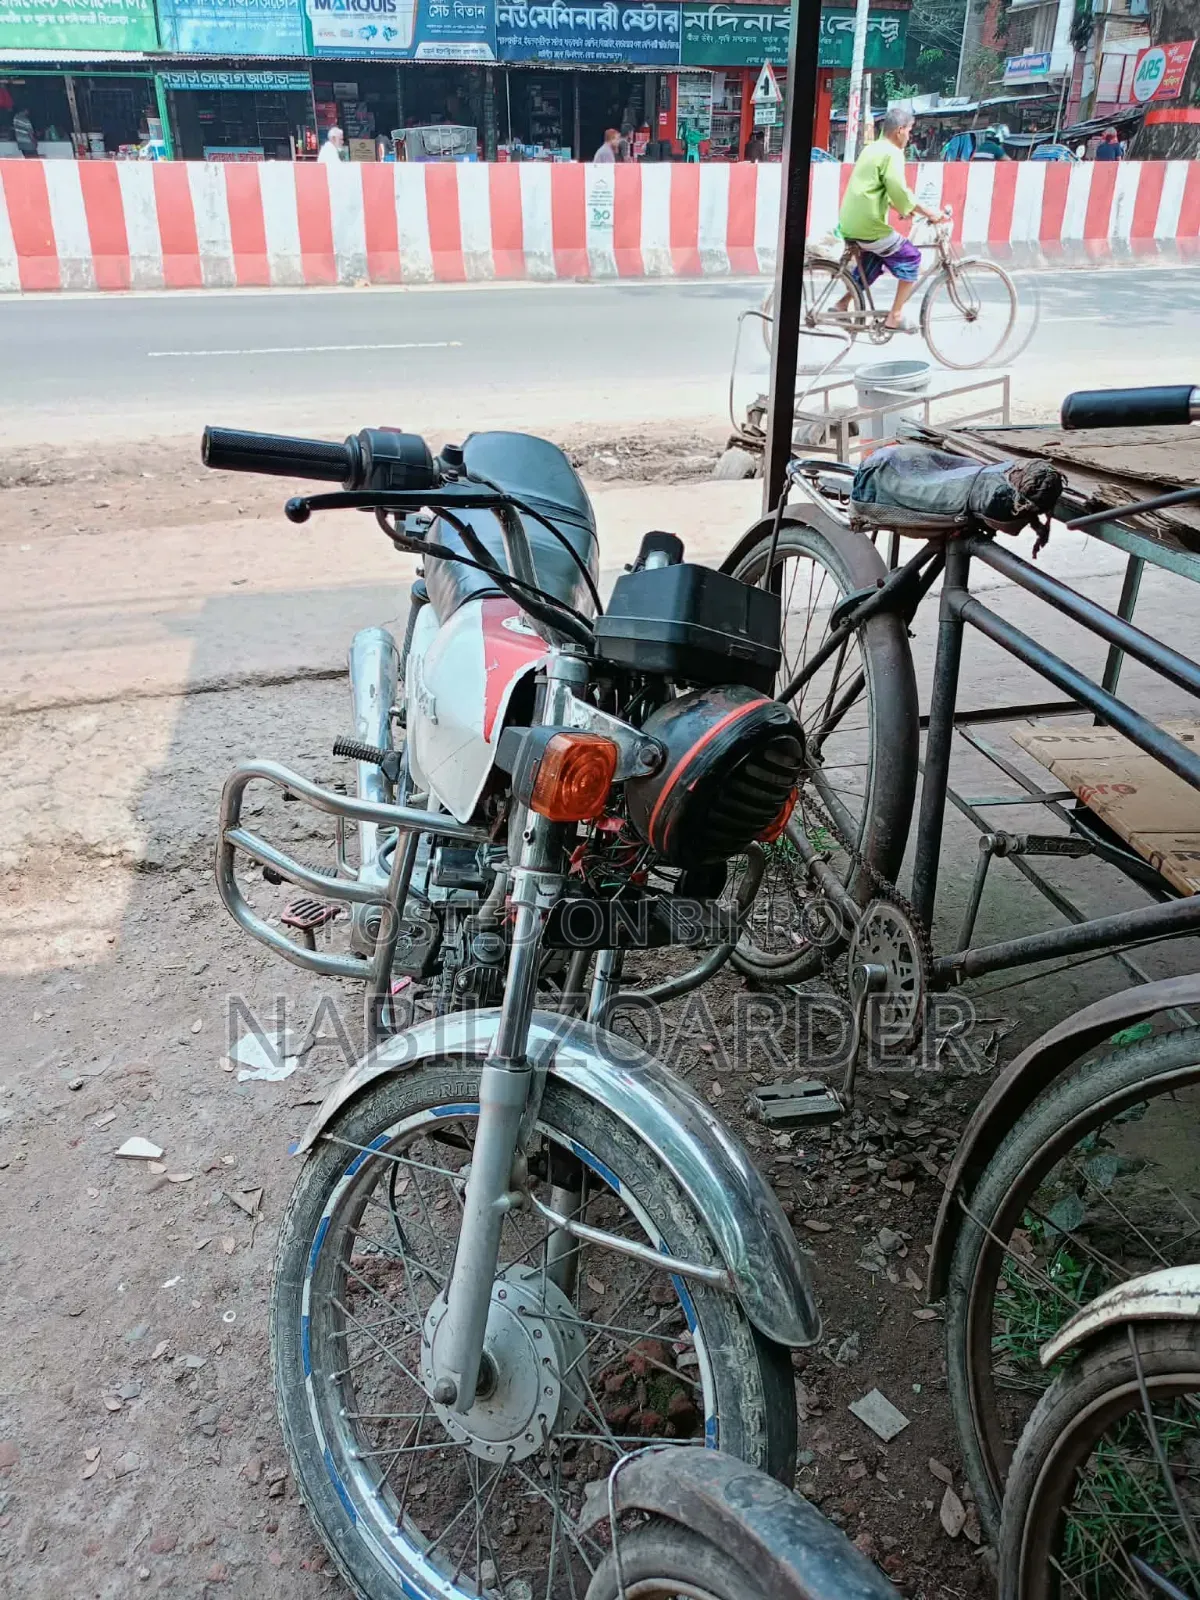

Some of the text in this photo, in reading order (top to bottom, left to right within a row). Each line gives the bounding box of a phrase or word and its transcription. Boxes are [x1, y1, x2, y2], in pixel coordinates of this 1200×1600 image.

[314, 0, 397, 13] MARQUIS
[428, 1, 486, 19] সেচ বিতান
[1137, 58, 1163, 81] ARS
